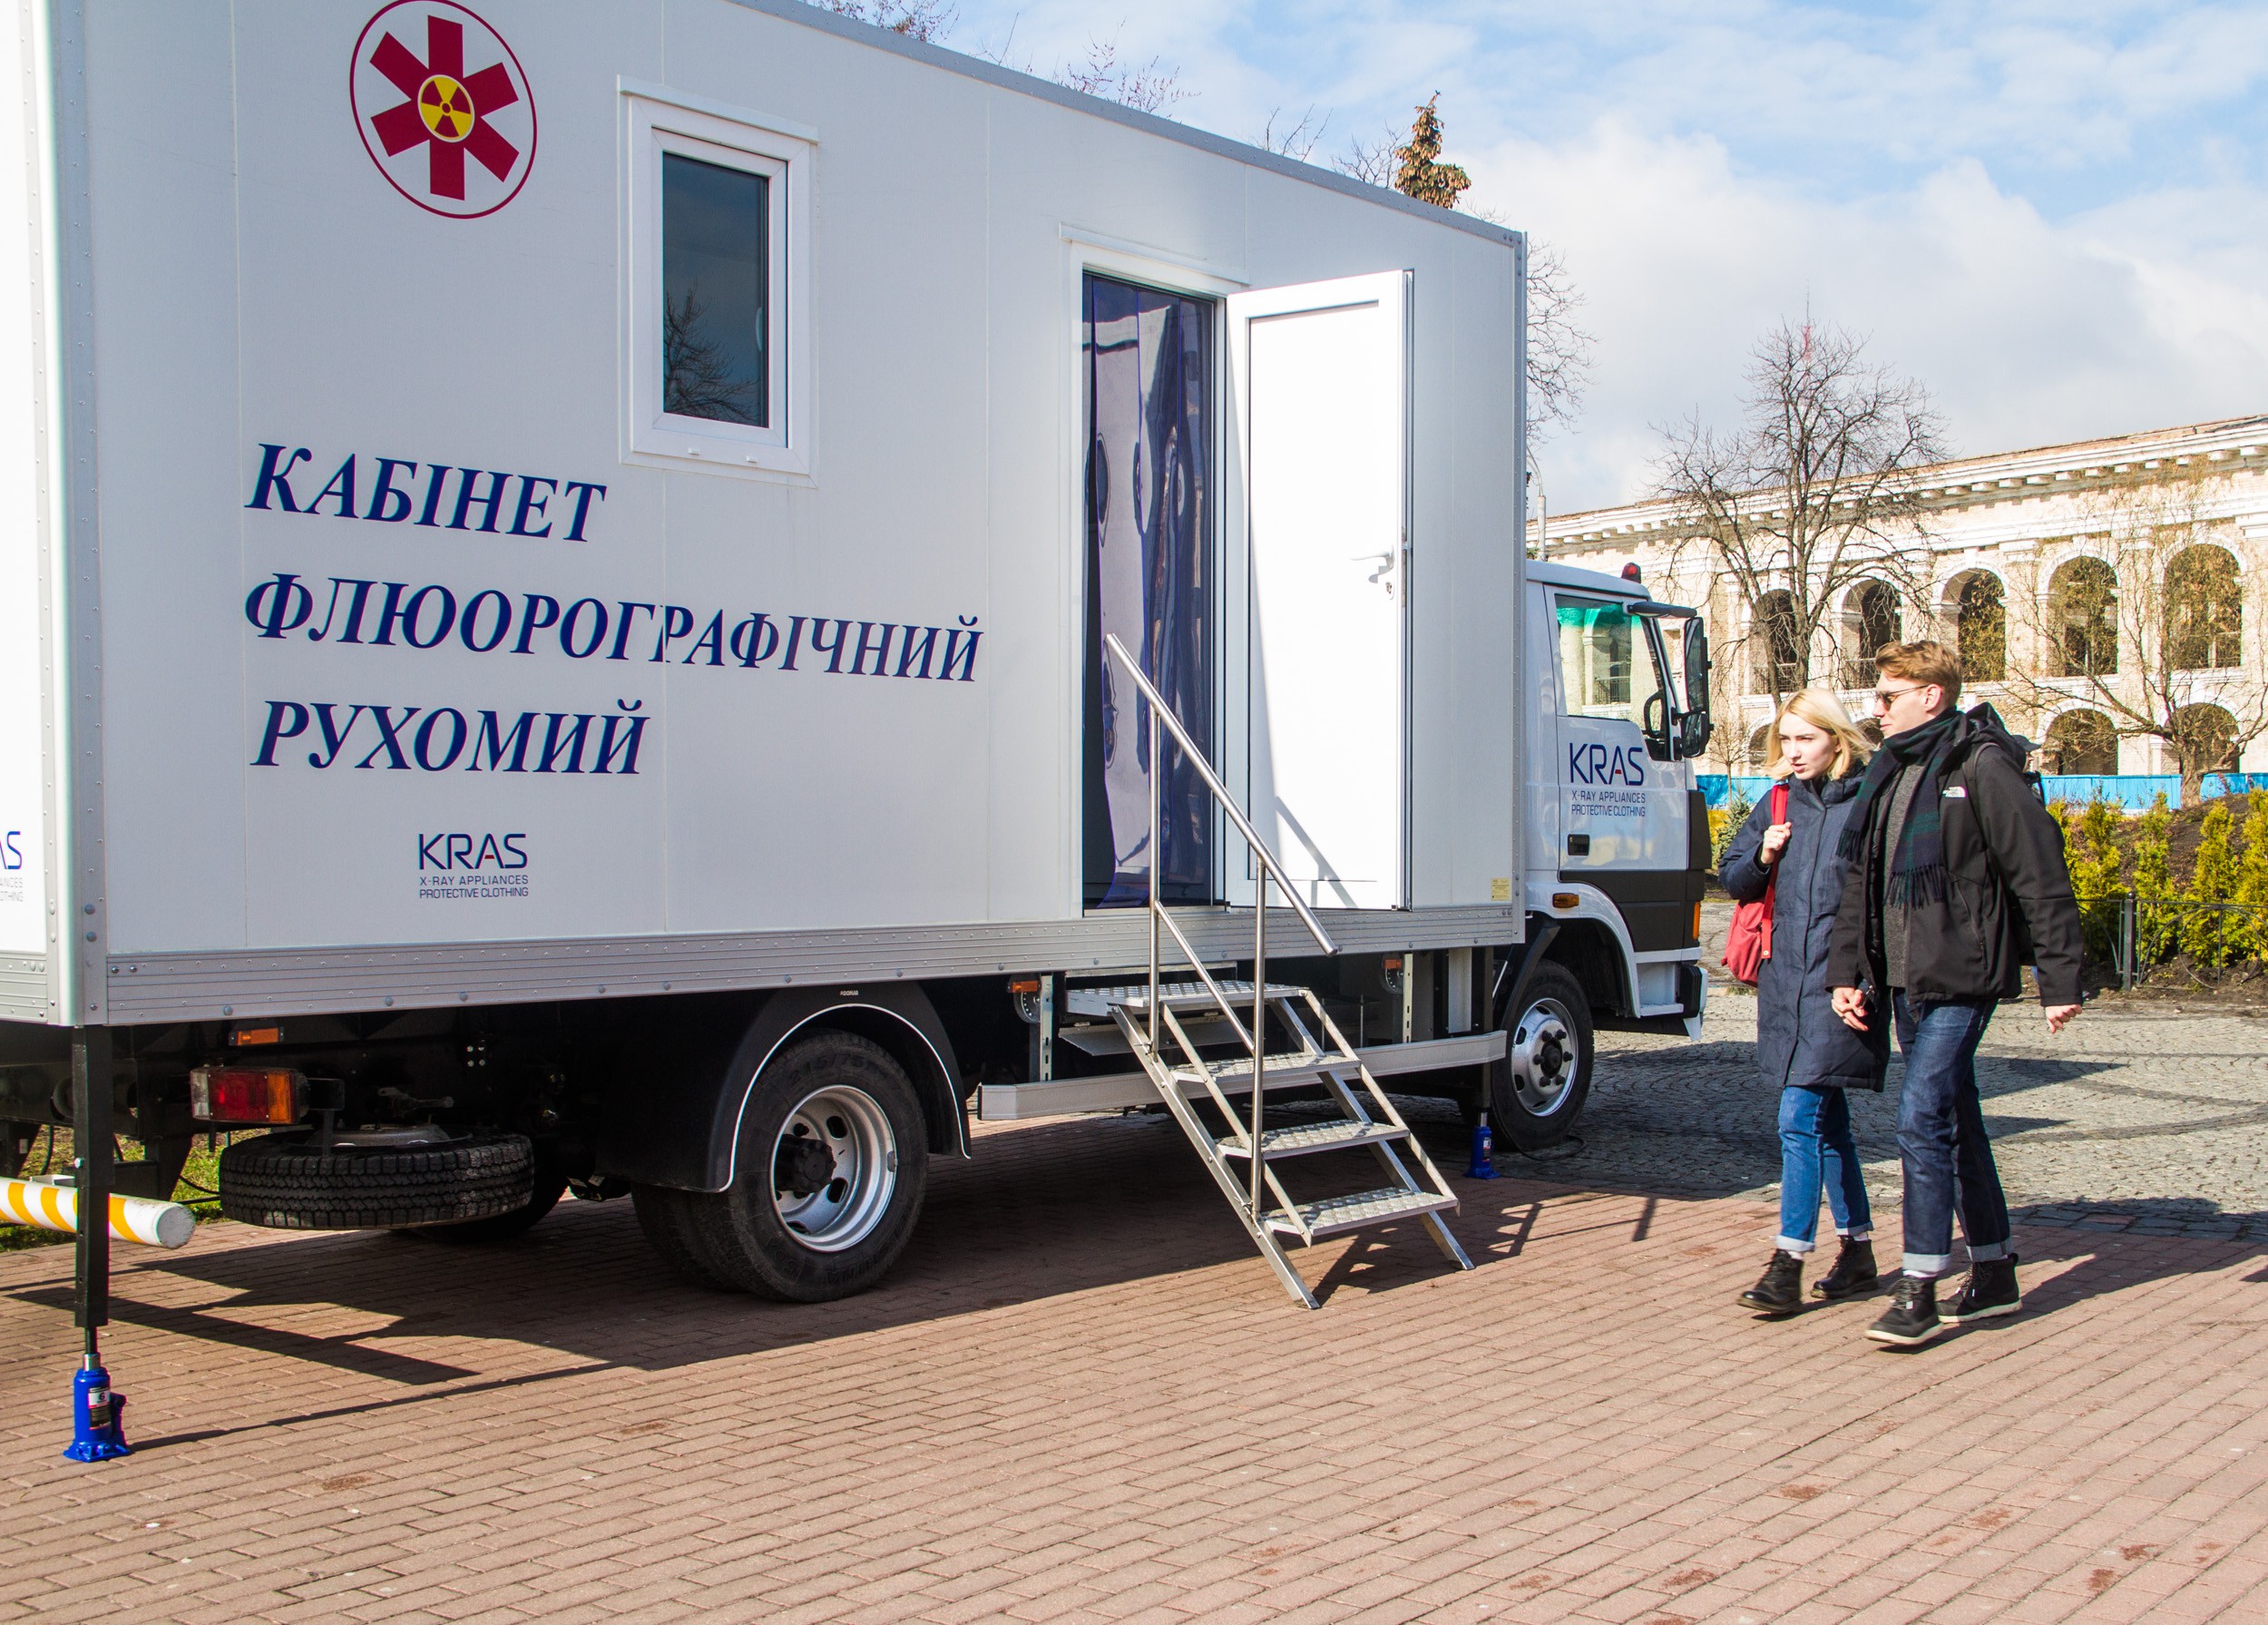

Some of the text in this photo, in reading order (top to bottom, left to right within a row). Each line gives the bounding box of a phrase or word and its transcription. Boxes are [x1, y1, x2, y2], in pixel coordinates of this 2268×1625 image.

[244, 443, 608, 543] КАБІНЕТ
[245, 573, 984, 682] ФЛЮОРОГРАФІЧНИЙ
[249, 698, 651, 775] РУХОМИЙ
[1569, 742, 1645, 787] KRAS
[1571, 789, 1646, 803] X-RAY APPLIANCES
[1571, 804, 1646, 817] PROTECTIVE CLOTHING
[418, 833, 528, 870] KRAS
[419, 874, 529, 886] X-RAY APPLIANCES
[419, 886, 529, 899] PROTECTIVE CLOTHING
